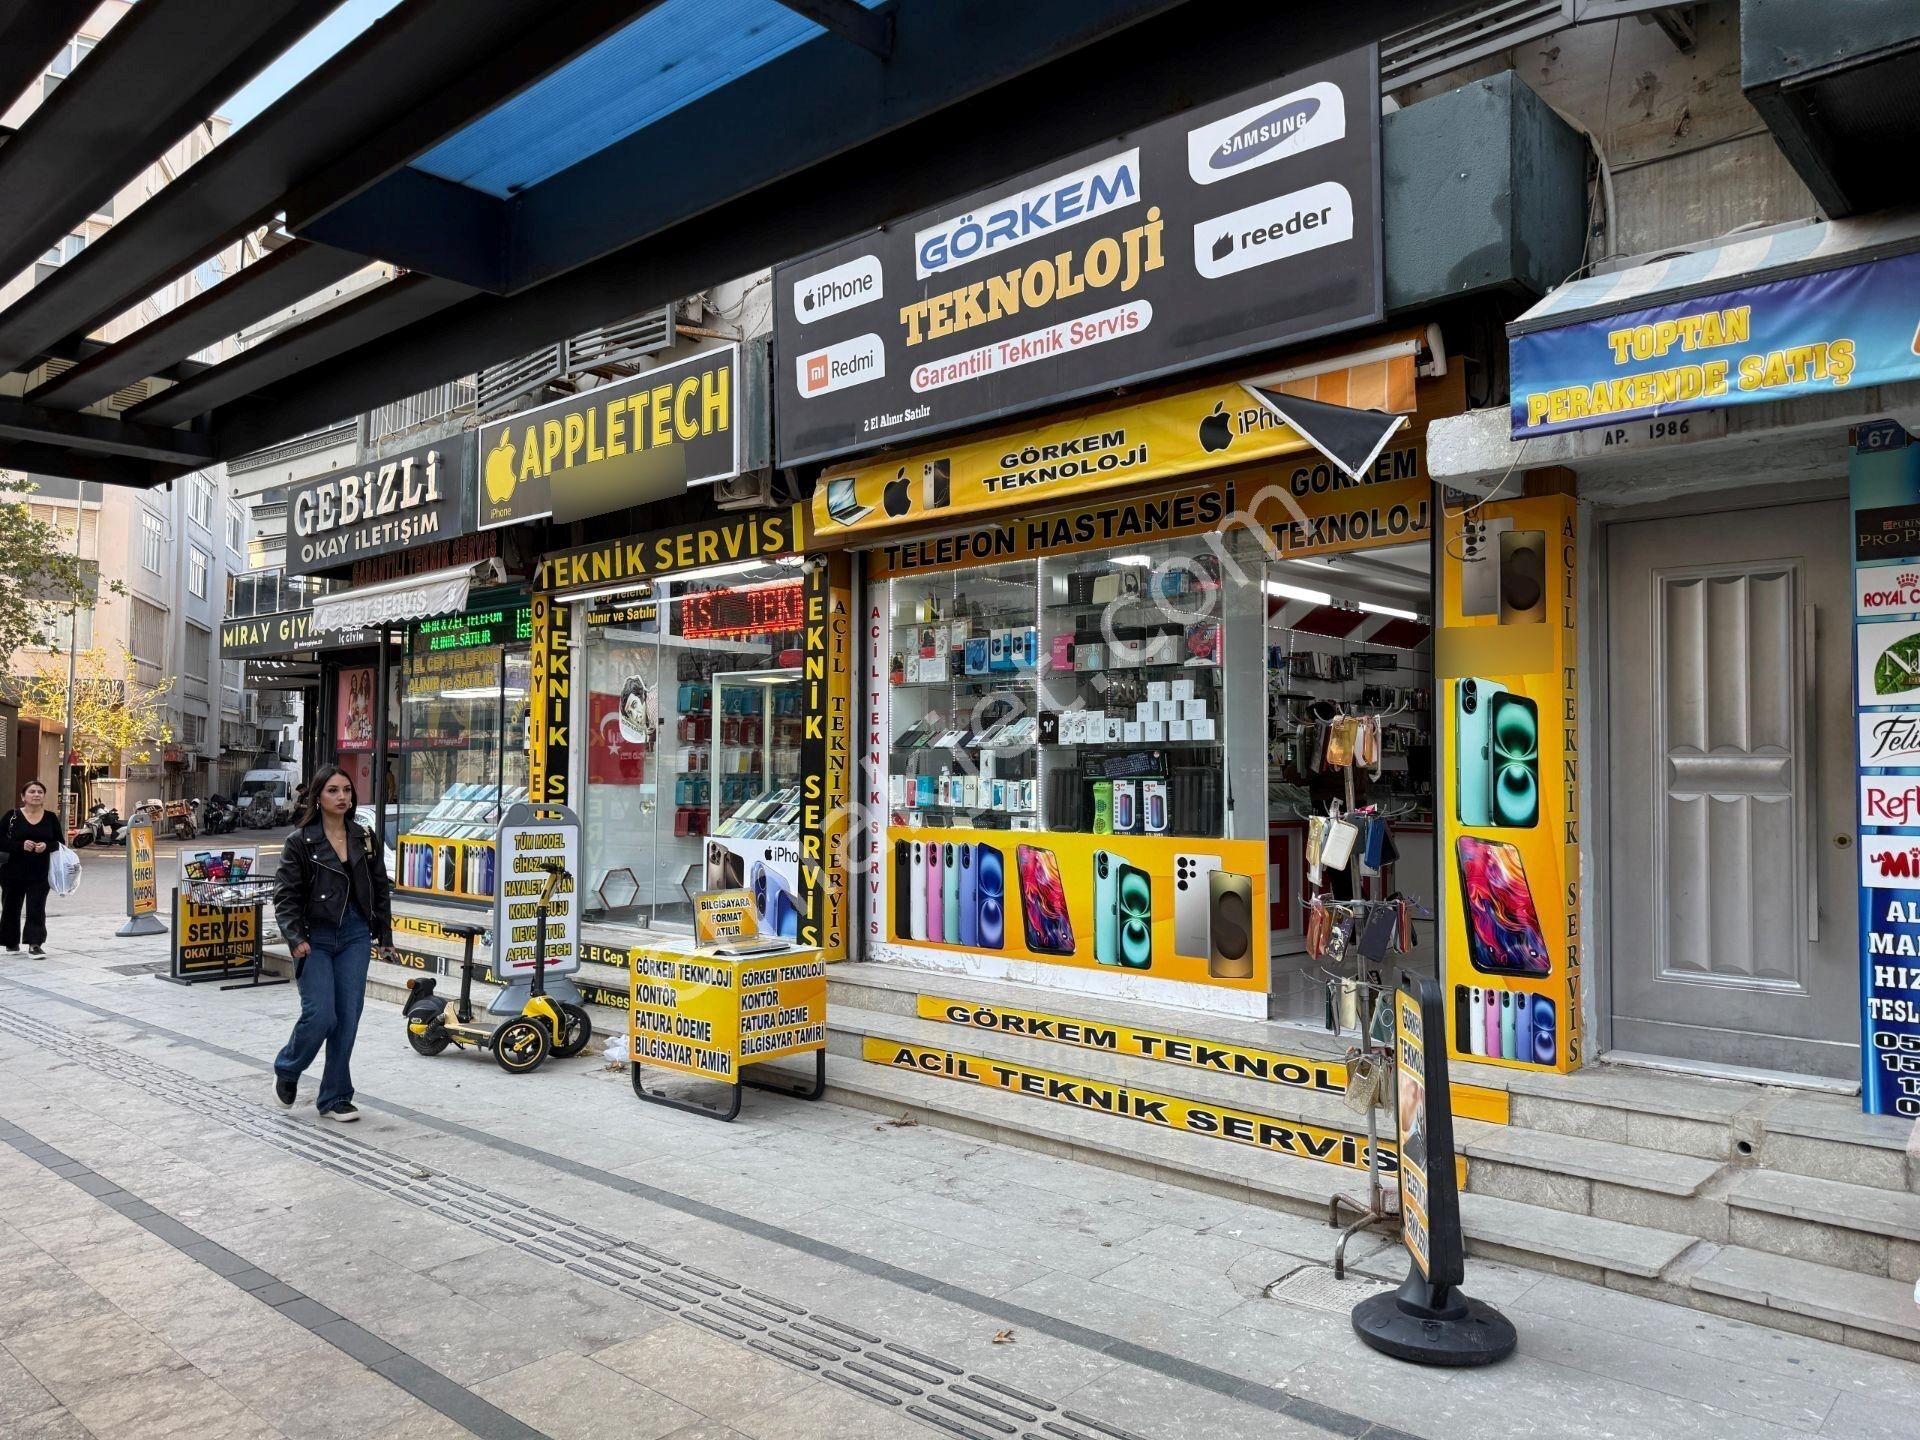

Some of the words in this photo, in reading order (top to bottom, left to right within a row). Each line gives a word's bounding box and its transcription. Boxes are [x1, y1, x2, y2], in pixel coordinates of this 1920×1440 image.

[1222, 110, 1307, 155] SAMSUNG
[919, 164, 1136, 271] GÖRKEM
[1241, 206, 1332, 250] reeder
[816, 271, 873, 307] iPhone
[900, 205, 1164, 347] TEKNOLOJİ
[916, 350, 993, 391] Garantili
[998, 330, 1063, 366] Teknik
[1069, 308, 1139, 345] Servis
[1608, 305, 1751, 365] TOPTAN
[831, 349, 874, 379] Redmi
[1527, 360, 1729, 427] PERAKENDE
[1737, 338, 1856, 391] SATIŞ
[519, 365, 731, 483] APPLETECH
[864, 420, 870, 431] 2
[870, 417, 880, 430] El
[882, 409, 903, 426] Alınır
[904, 405, 931, 422] Satılır
[1604, 428, 1629, 446] AP.
[1649, 418, 1690, 441] 1986
[1868, 426, 1895, 448] 67
[983, 443, 1148, 493] TEKNOLOJİ
[1000, 429, 1127, 470] GÖRKEM
[490, 504, 512, 518] iPhone
[884, 531, 1016, 572] TELEFON
[1026, 480, 1237, 549] HASTANESİ
[301, 535, 351, 564] OKAY
[542, 540, 645, 592] TEKNİK
[655, 511, 785, 570] SERVİS
[1860, 533, 1900, 547] PRO
[1562, 515, 1576, 630] ACİL
[587, 612, 612, 625] Alınır
[613, 611, 625, 622] ve
[627, 605, 657, 621] Satılır
[1864, 589, 1906, 608] ROYAL
[223, 621, 271, 648] MİRAY
[533, 600, 545, 693] OKAY
[804, 565, 826, 740] TEKNİK
[831, 599, 848, 674] ACİL
[869, 606, 881, 678] ACİL
[549, 606, 569, 747] TEKNİK
[829, 696, 848, 810] TEKNİK
[869, 692, 881, 805] TEKNİK
[1563, 667, 1580, 844] TEKNİK
[514, 832, 535, 851] TÜM
[535, 832, 565, 850] MODEL
[801, 774, 822, 947] SERVİS
[504, 880, 542, 897] HAYALET
[828, 832, 844, 948] SERVİS
[869, 821, 881, 935] SERVİS
[509, 900, 569, 920] KORUYCUSU
[700, 897, 750, 911] BİLGİSAYARA
[711, 911, 742, 924] FORMAT
[506, 942, 572, 961] APPLTECH
[716, 926, 740, 937] ATILIR
[184, 947, 211, 960] OKAY
[590, 947, 600, 960] El
[603, 949, 624, 967] Cep
[637, 956, 676, 980] GÖRKEM
[679, 962, 732, 989] TEKNOLOJİ
[741, 967, 778, 988] GÖRKEM
[779, 958, 825, 981] TEKNOLOJİ
[1565, 882, 1580, 1063] SERVİS
[636, 983, 677, 1008] KONTÖR
[741, 988, 779, 1011] KONTÖR
[635, 1009, 673, 1035] FATURA
[676, 1013, 711, 1042] ÖDEME
[740, 1030, 792, 1056] BİLGİSAYAR
[795, 1020, 825, 1044] TAMİRİ
[741, 1012, 776, 1034] FATURA
[778, 1005, 808, 1027] ÖDEME
[946, 1004, 1118, 1049] GÖRKEM
[635, 1035, 693, 1067] BİLGİSAYAR
[695, 1048, 731, 1075] TAMİRİ
[893, 1046, 980, 1081] ACİL
[992, 1065, 1172, 1124] TEKNİK
[1186, 1108, 1398, 1174] SERVİS
